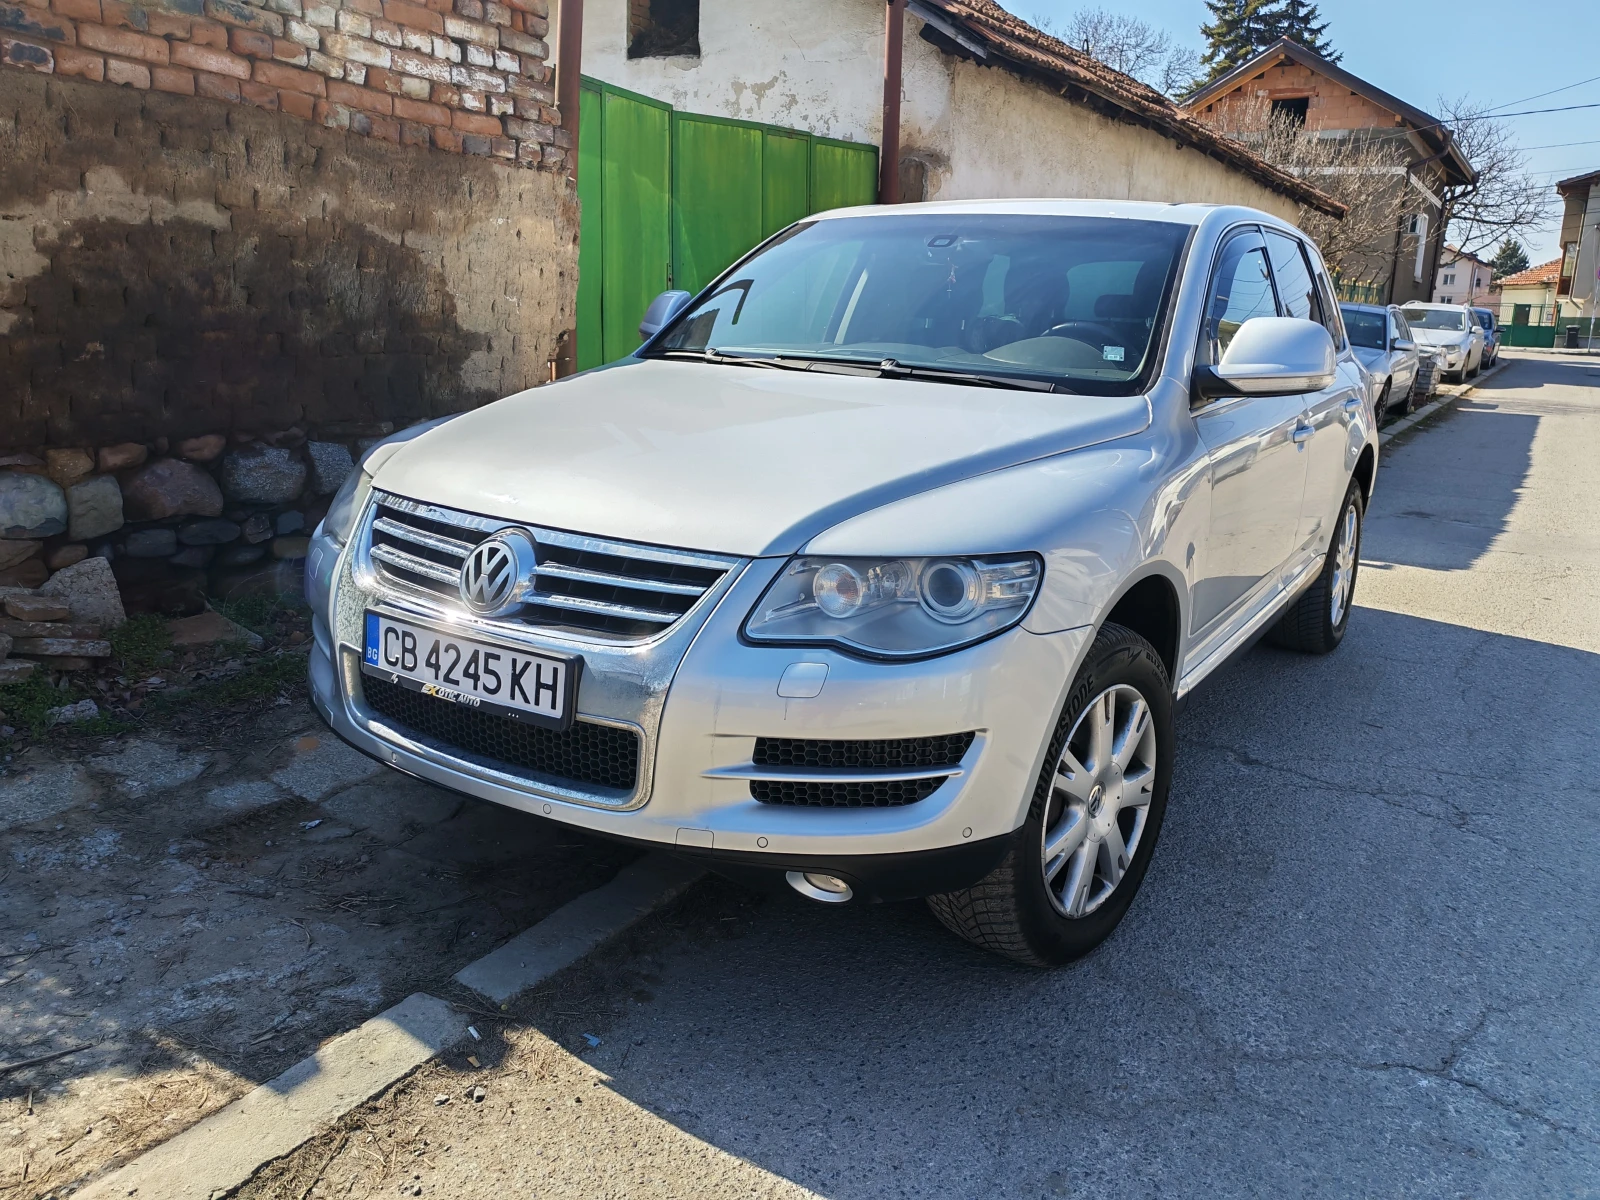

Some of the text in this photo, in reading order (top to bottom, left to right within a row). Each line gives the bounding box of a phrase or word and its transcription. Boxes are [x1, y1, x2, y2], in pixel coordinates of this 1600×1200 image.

[463, 541, 513, 607] VW
[367, 646, 378, 660] BG
[384, 626, 559, 711] CB 4245 KH
[421, 683, 481, 708] EXOTIC AUTO
[1028, 673, 1095, 822] BRIDGESTONE
